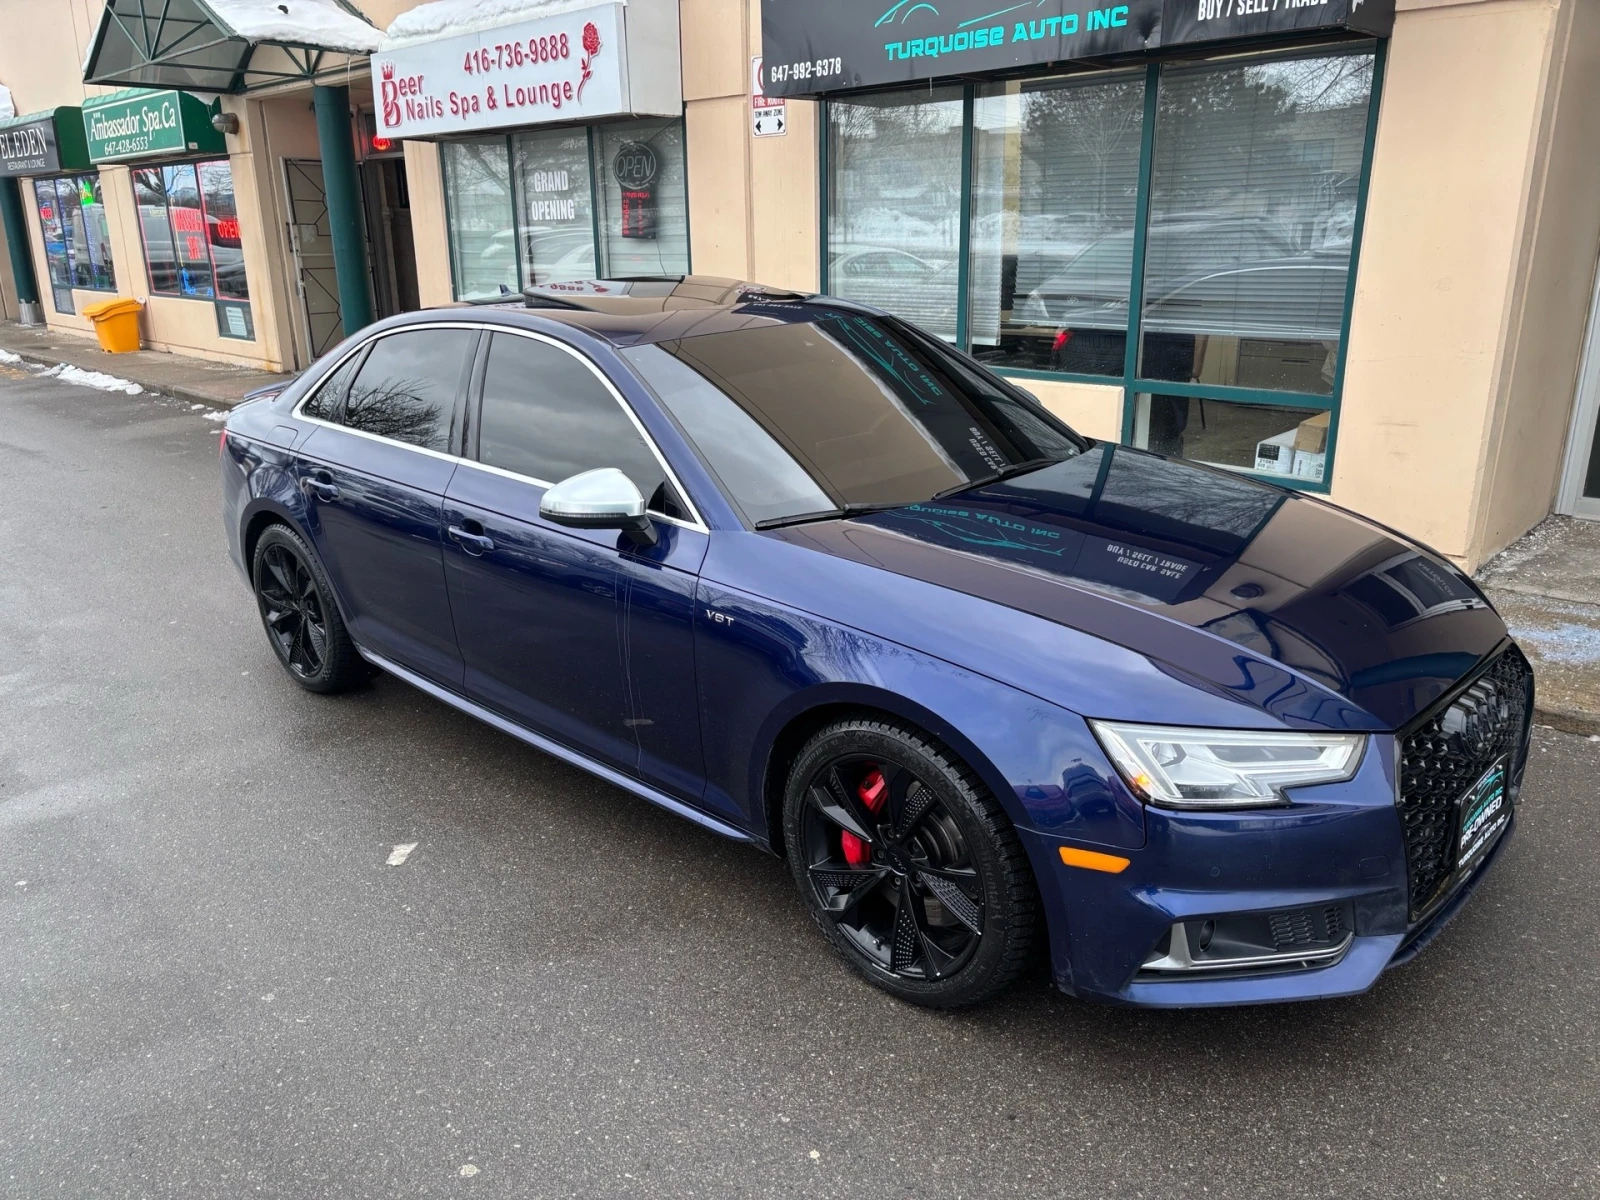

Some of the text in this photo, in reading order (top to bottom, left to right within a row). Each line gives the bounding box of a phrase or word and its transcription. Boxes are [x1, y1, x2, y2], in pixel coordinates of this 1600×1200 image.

[884, 5, 1129, 61] TURQUOISE AUTO INC
[463, 33, 571, 75] 416-736-9888
[771, 57, 842, 83] 647-992-6378
[405, 80, 574, 121] Nails Spa & Lounge
[90, 102, 176, 141] Ambassador Spa.Ca
[104, 136, 149, 155] 647-428-6553
[616, 156, 652, 177] OPEN
[534, 170, 569, 192] GRAND
[531, 199, 575, 221] OPENING
[218, 220, 242, 238] OPEN
